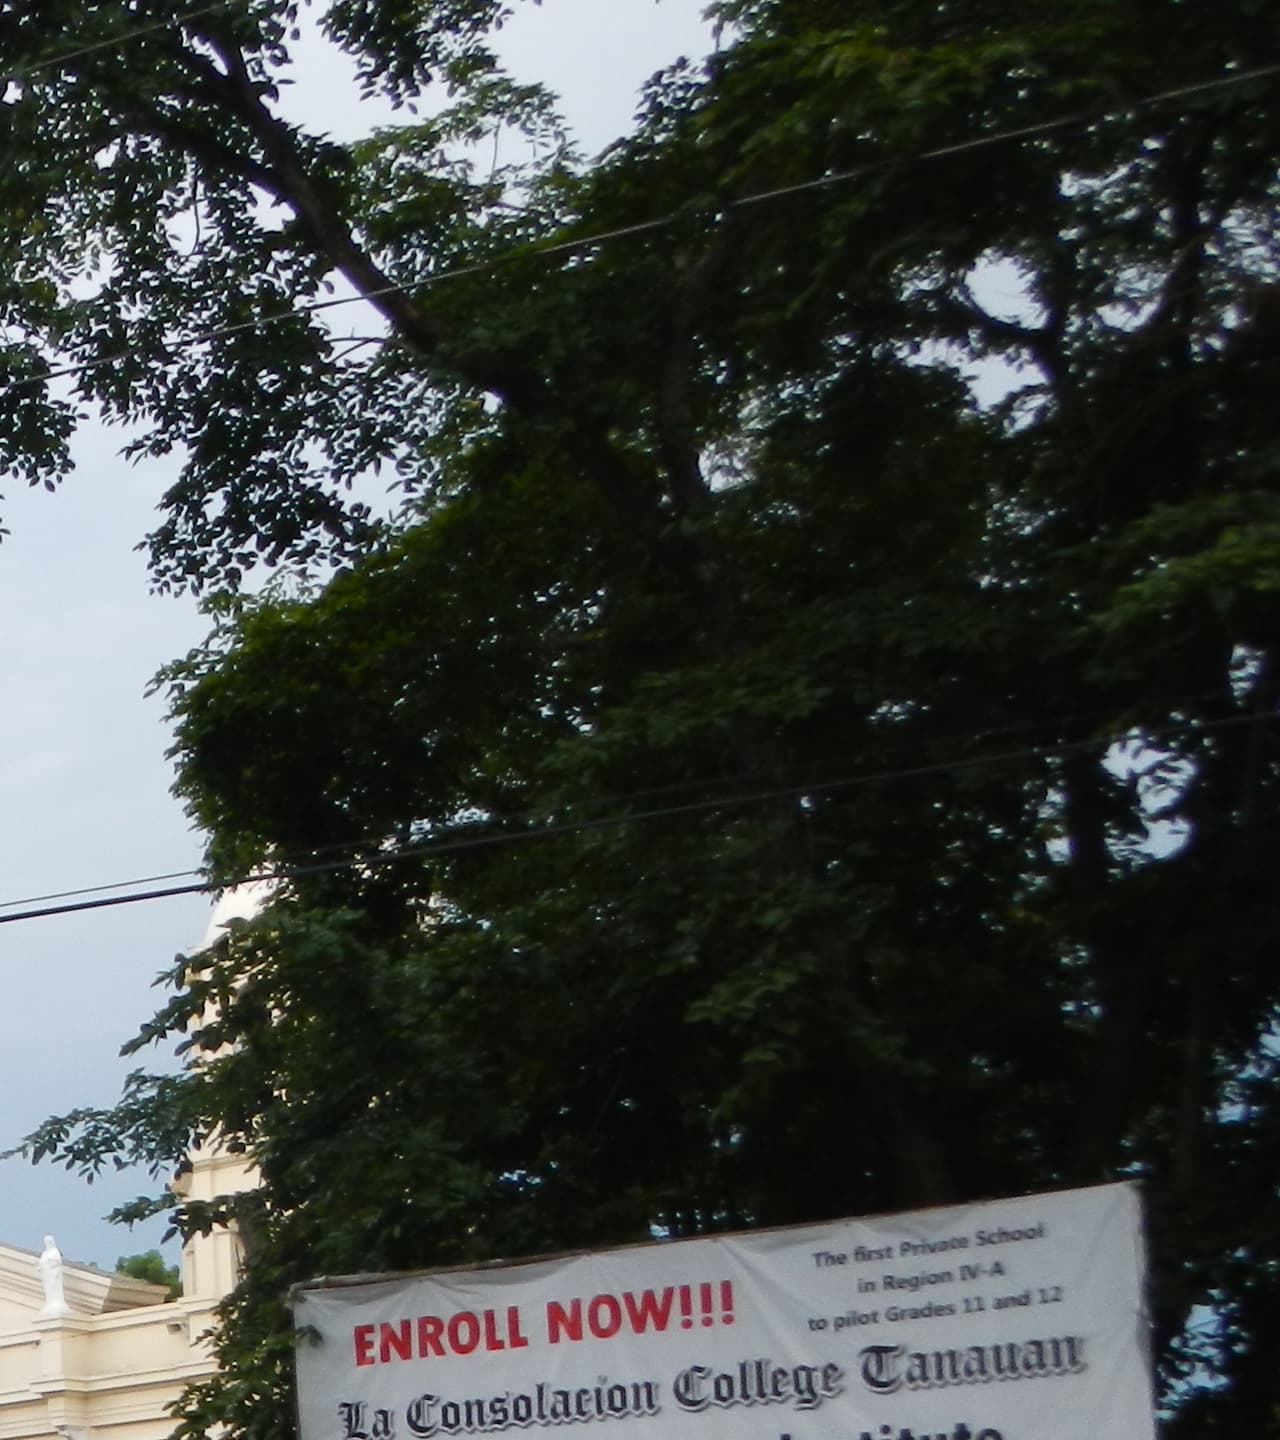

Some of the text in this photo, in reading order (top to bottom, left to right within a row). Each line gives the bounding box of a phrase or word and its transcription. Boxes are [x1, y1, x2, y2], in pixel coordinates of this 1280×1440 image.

[812, 1223, 1045, 1269] The first Private School
[858, 1261, 1005, 1294] in Region IV-A
[353, 1280, 735, 1366] ENROLL NOW!!!
[809, 1286, 1063, 1333] to pilot Grades 11 and 12
[406, 1375, 661, 1439] Consolacion
[673, 1359, 846, 1412] College
[859, 1335, 1089, 1395] Tanauan
